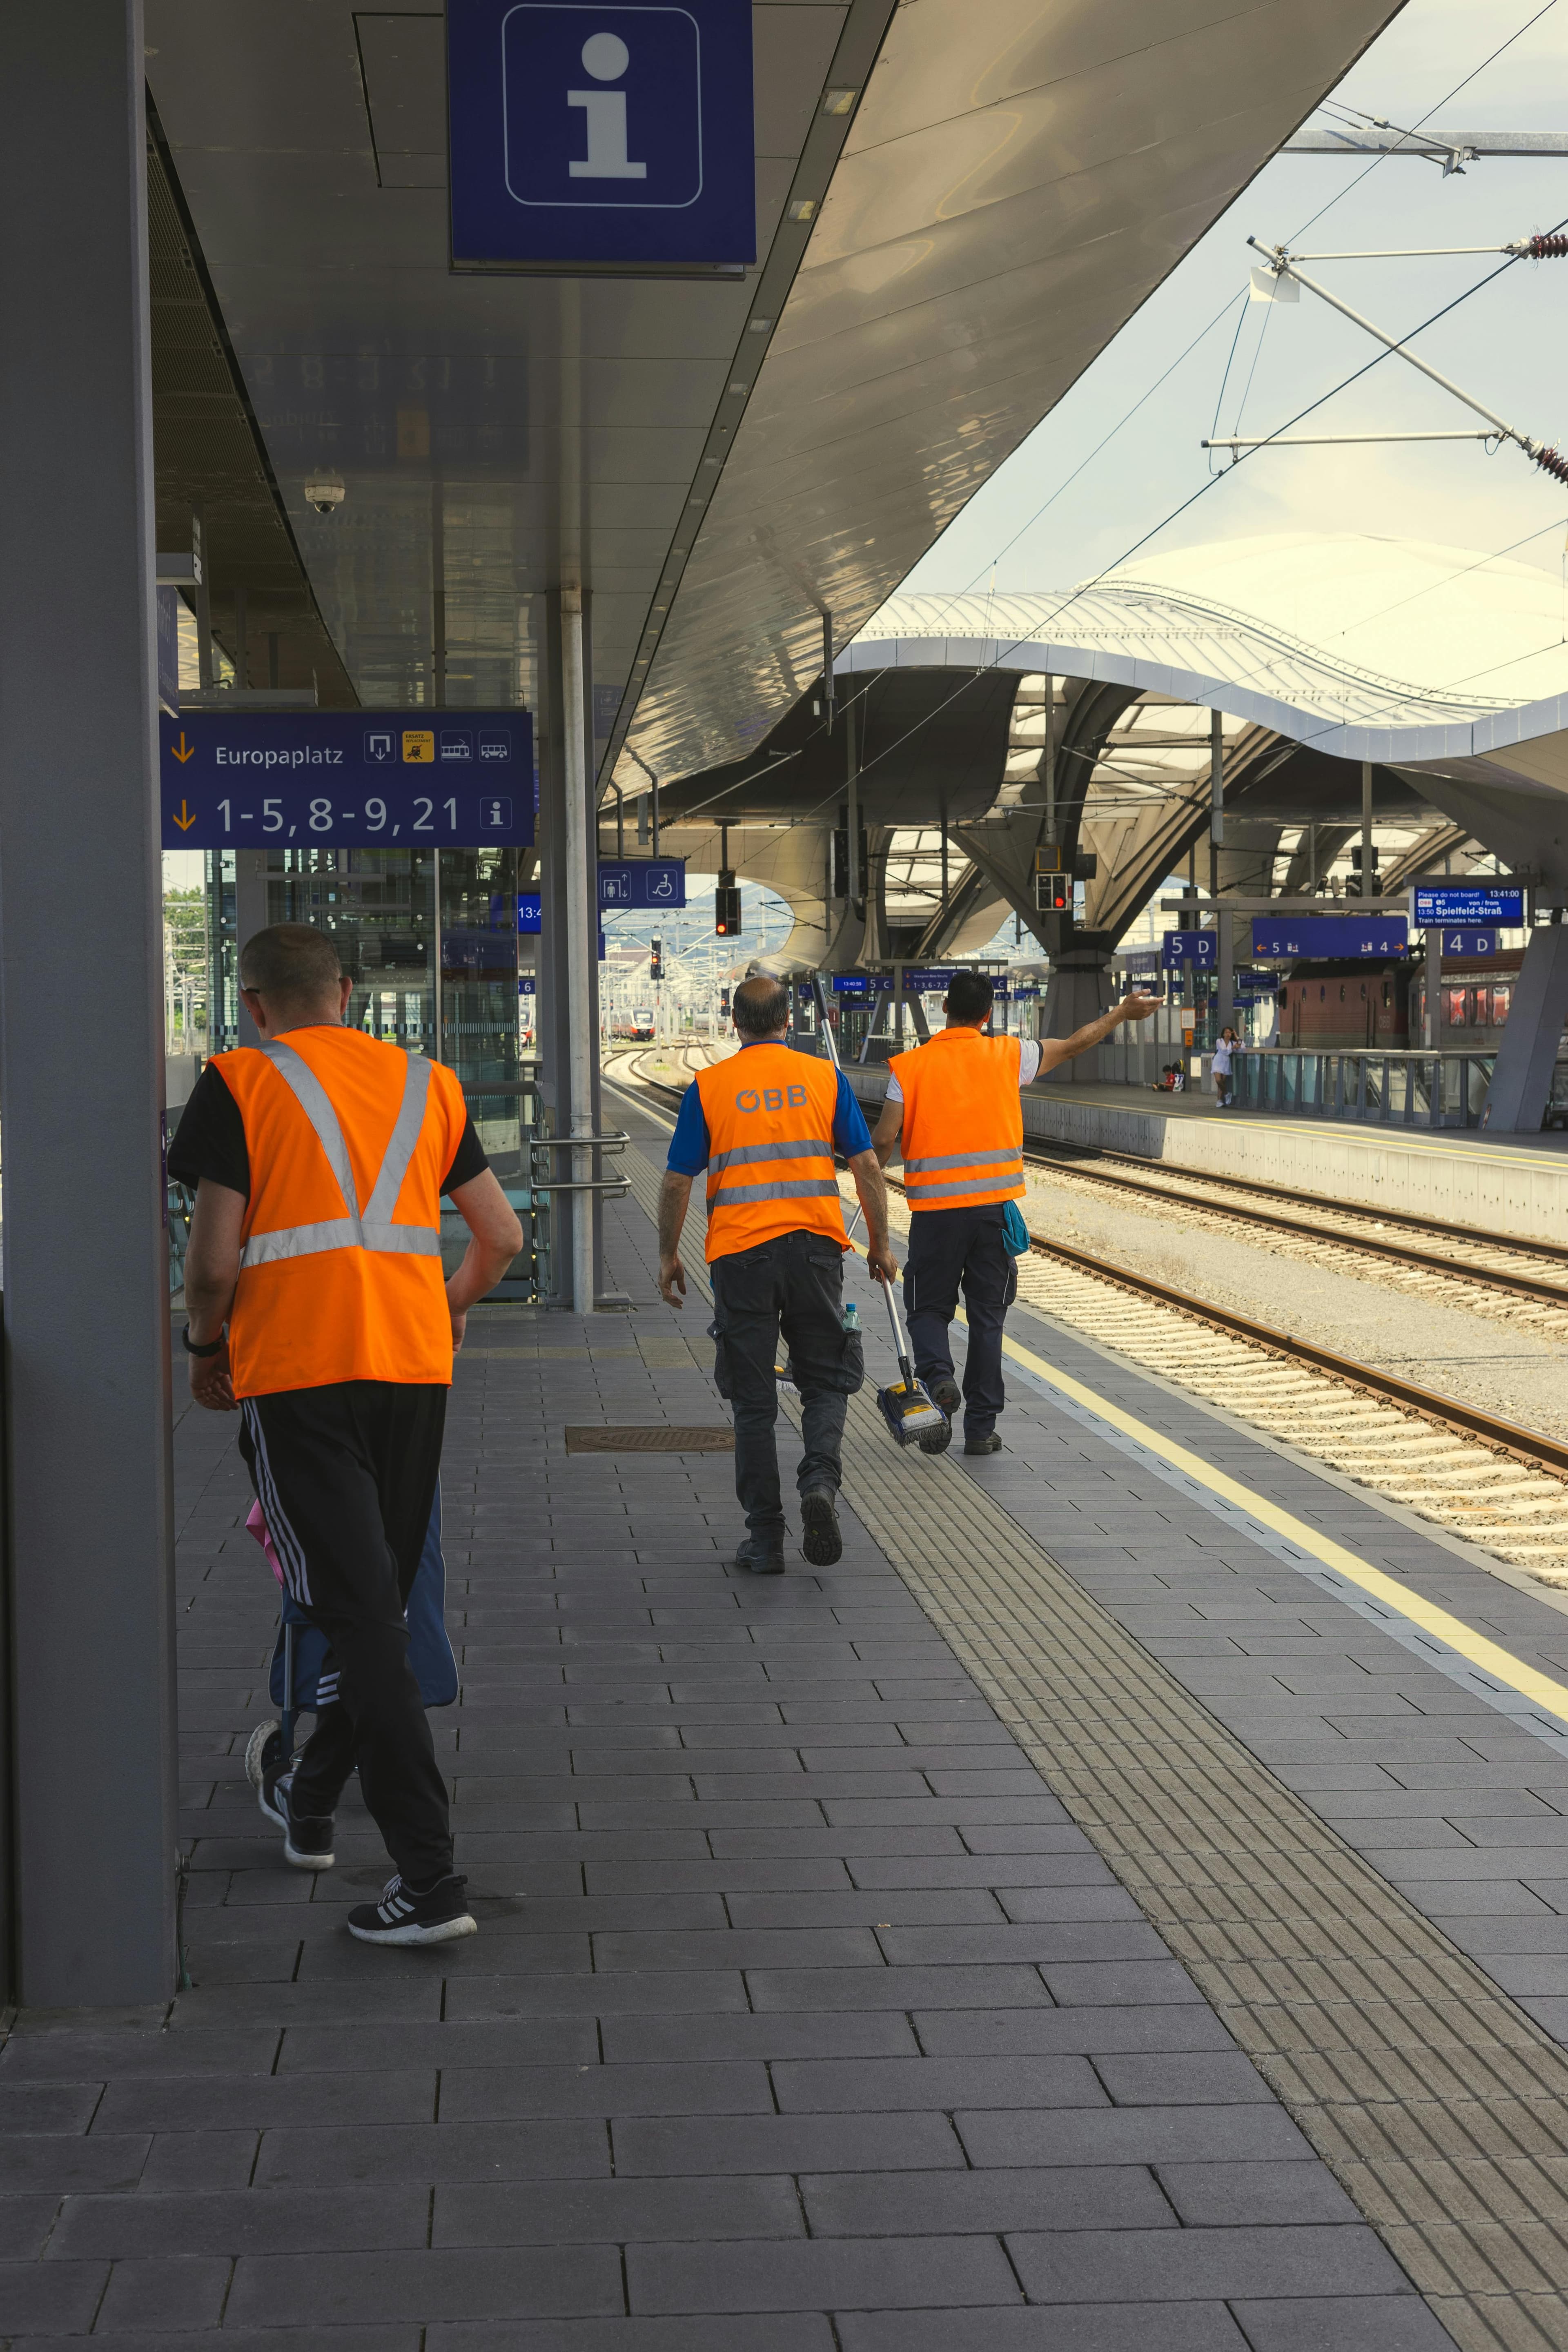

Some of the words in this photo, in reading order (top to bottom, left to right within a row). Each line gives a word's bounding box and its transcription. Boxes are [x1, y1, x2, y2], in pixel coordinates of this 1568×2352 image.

[216, 746, 343, 769] Europaplatz
[1436, 907, 1502, 916] Spielfeld-Straß
[1172, 937, 1183, 953] 5
[1199, 941, 1209, 953] D
[1273, 942, 1279, 953] 5
[1380, 942, 1388, 952] 4
[1450, 935, 1463, 951] 4
[1477, 938, 1488, 951] D
[525, 982, 531, 992] 6
[870, 979, 876, 989] 5
[735, 1085, 807, 1113] ÖBB
